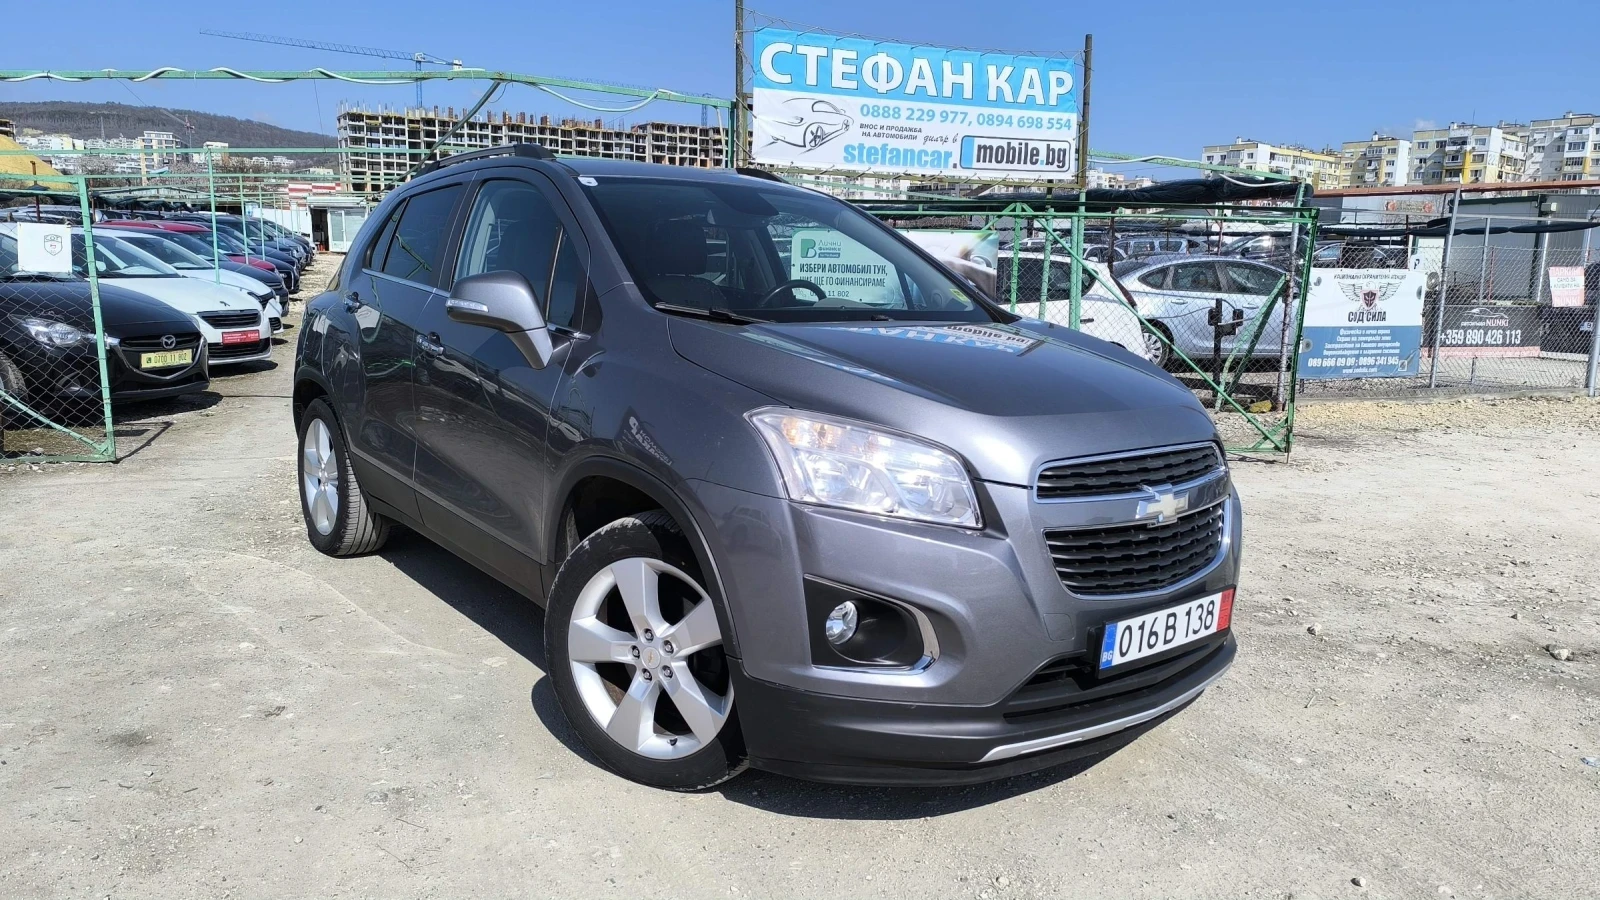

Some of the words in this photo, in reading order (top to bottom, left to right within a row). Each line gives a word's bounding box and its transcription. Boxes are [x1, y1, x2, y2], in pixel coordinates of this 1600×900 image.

[760, 42, 973, 100] СТЕФАН
[987, 64, 1074, 107] КАР
[860, 104, 901, 119] 0888
[905, 107, 936, 122] 229
[939, 110, 972, 127] 977,
[976, 112, 1014, 127] 0894
[1017, 115, 1043, 130] 698
[1046, 118, 1072, 131] 554
[873, 132, 918, 141] АВТОМОБИЛИ
[976, 141, 1067, 169] mobile.bg
[799, 263, 826, 273] ИЗБЕРИ
[828, 264, 871, 274] АВТОМОБИЛ
[873, 264, 888, 277] ТУК,
[826, 276, 834, 285] ГО
[834, 276, 886, 287] ФИНАНСИРАМЕ
[1366, 310, 1387, 322] СИЛА
[1486, 318, 1509, 326] NUNKI
[1440, 329, 1464, 344] +359
[1466, 329, 1484, 344] 890
[1485, 329, 1503, 344] 426
[1506, 329, 1521, 344] 113
[1308, 358, 1321, 367] 089
[1322, 358, 1336, 367] 666
[1359, 356, 1375, 366] 0896
[1375, 356, 1387, 365] 341
[1387, 356, 1399, 365] 945
[1102, 650, 1113, 662] BG
